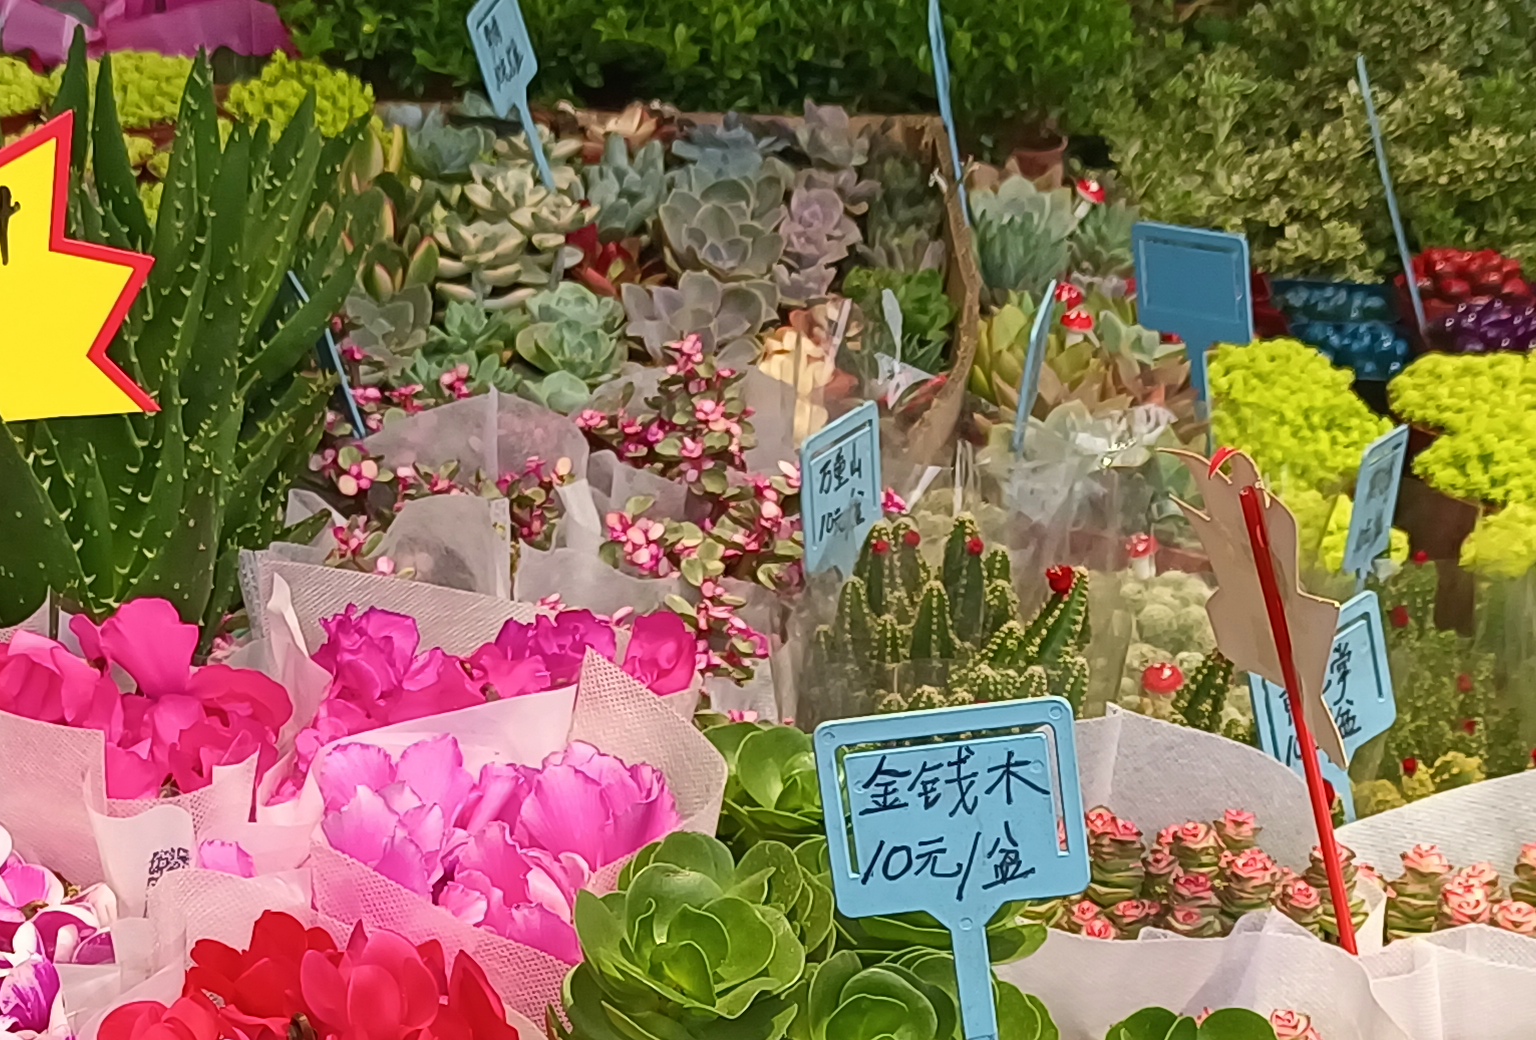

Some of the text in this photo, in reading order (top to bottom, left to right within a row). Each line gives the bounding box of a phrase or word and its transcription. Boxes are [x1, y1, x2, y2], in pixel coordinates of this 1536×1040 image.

[859, 746, 1051, 817] 金钱木
[861, 820, 1036, 901] 10元/盆
